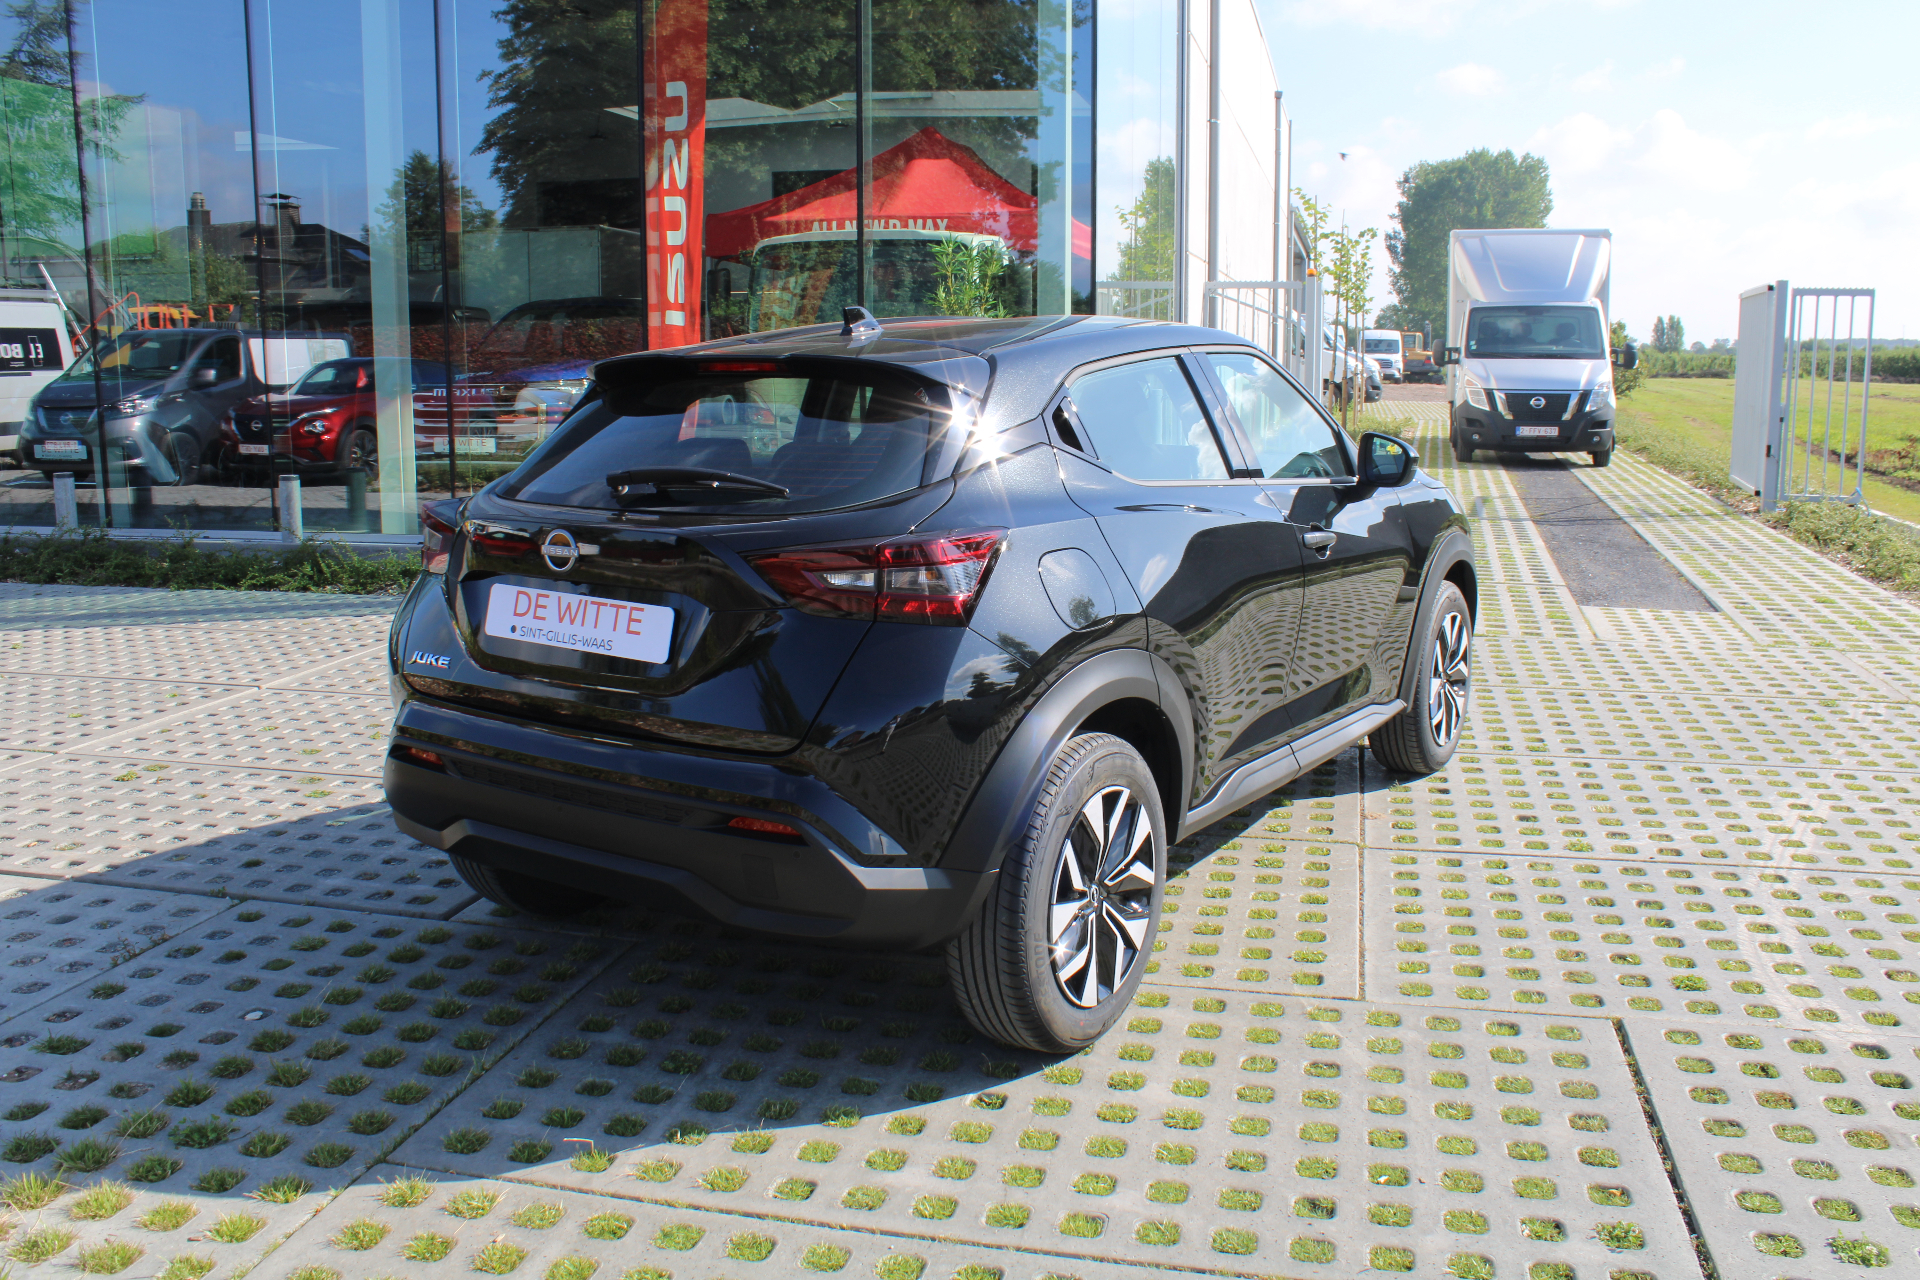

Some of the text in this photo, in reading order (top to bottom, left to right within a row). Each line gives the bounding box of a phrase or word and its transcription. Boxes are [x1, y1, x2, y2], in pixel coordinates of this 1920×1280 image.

[663, 81, 688, 326] ISUZU
[541, 546, 579, 556] NISSAN
[513, 590, 645, 636] DE WITTE
[519, 625, 613, 651] SINT-GILLIS-WAAS
[407, 650, 452, 669] JUKE
